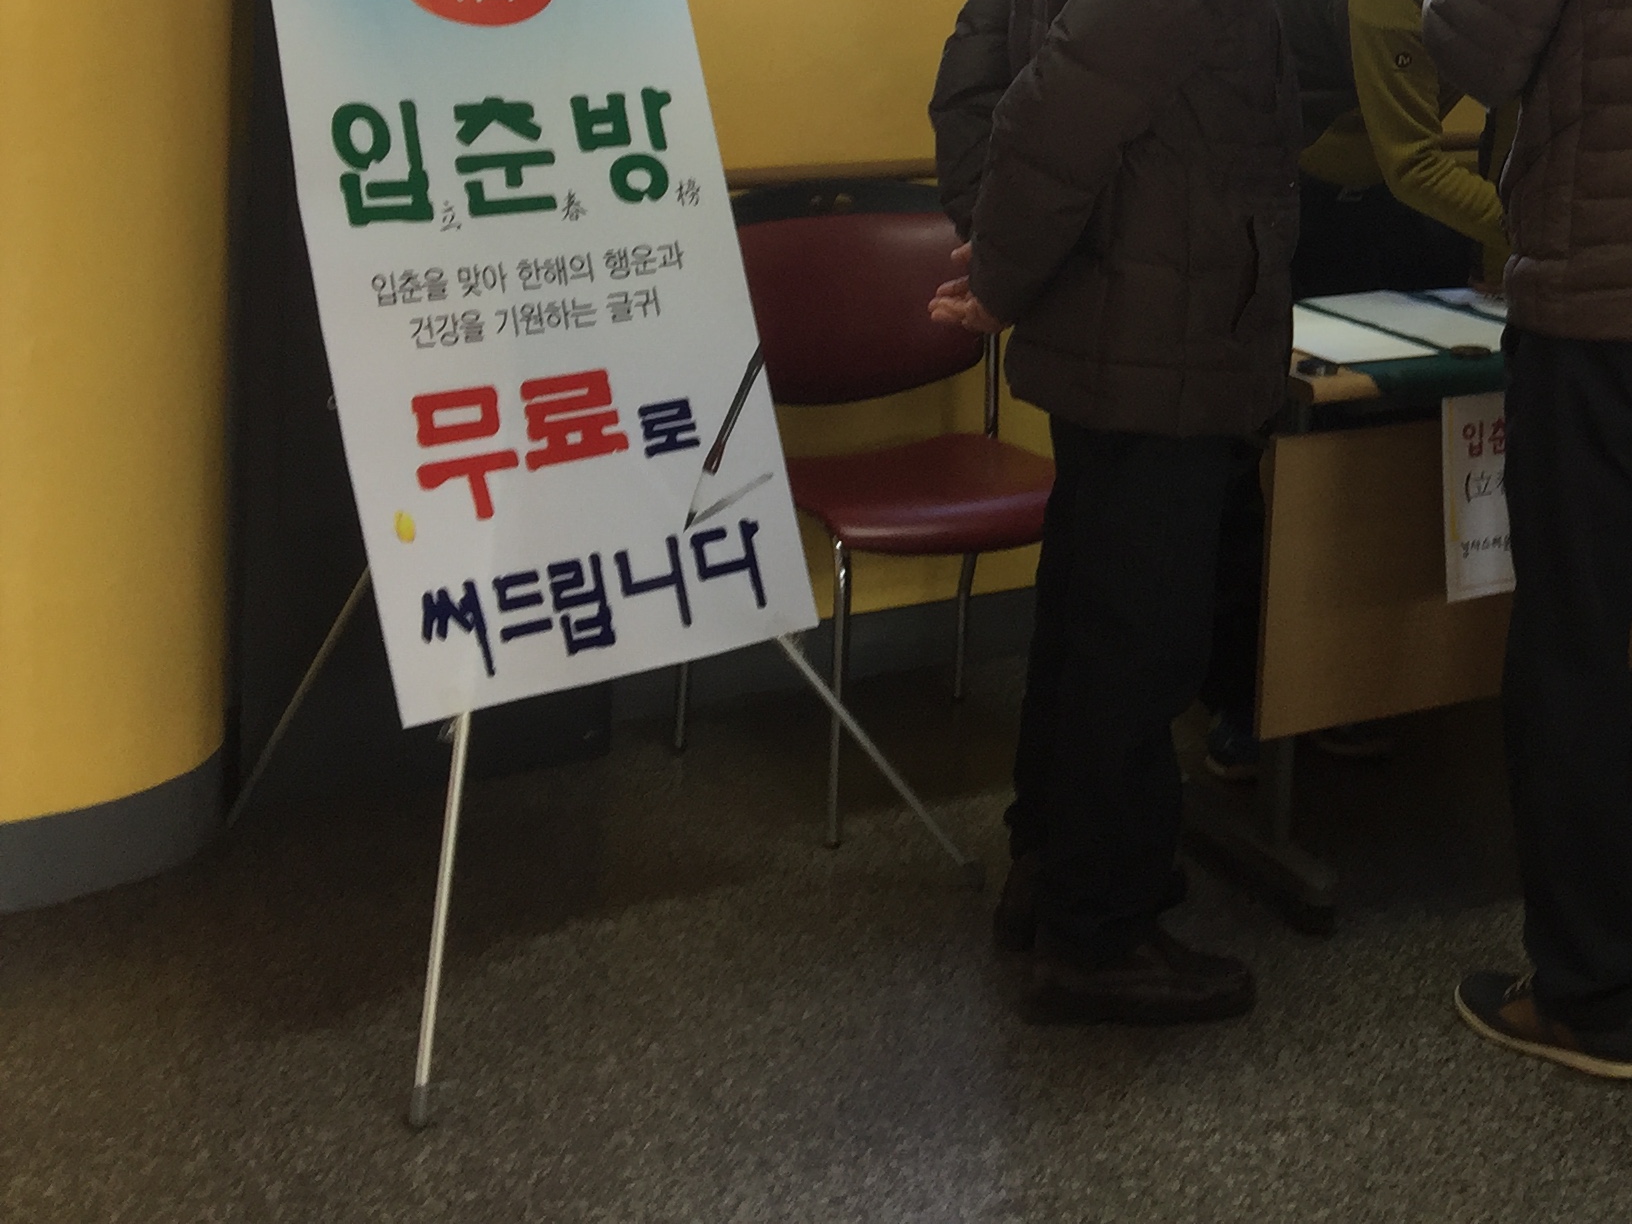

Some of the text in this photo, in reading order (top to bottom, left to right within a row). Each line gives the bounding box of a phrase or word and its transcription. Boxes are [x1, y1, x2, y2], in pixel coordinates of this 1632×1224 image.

[331, 87, 672, 227] 입춘방
[370, 240, 685, 308] 입춘을 맞아 한해의 행운과
[408, 287, 662, 349] 건강을 기원하는 글귀
[421, 519, 768, 677] 써드립니다
